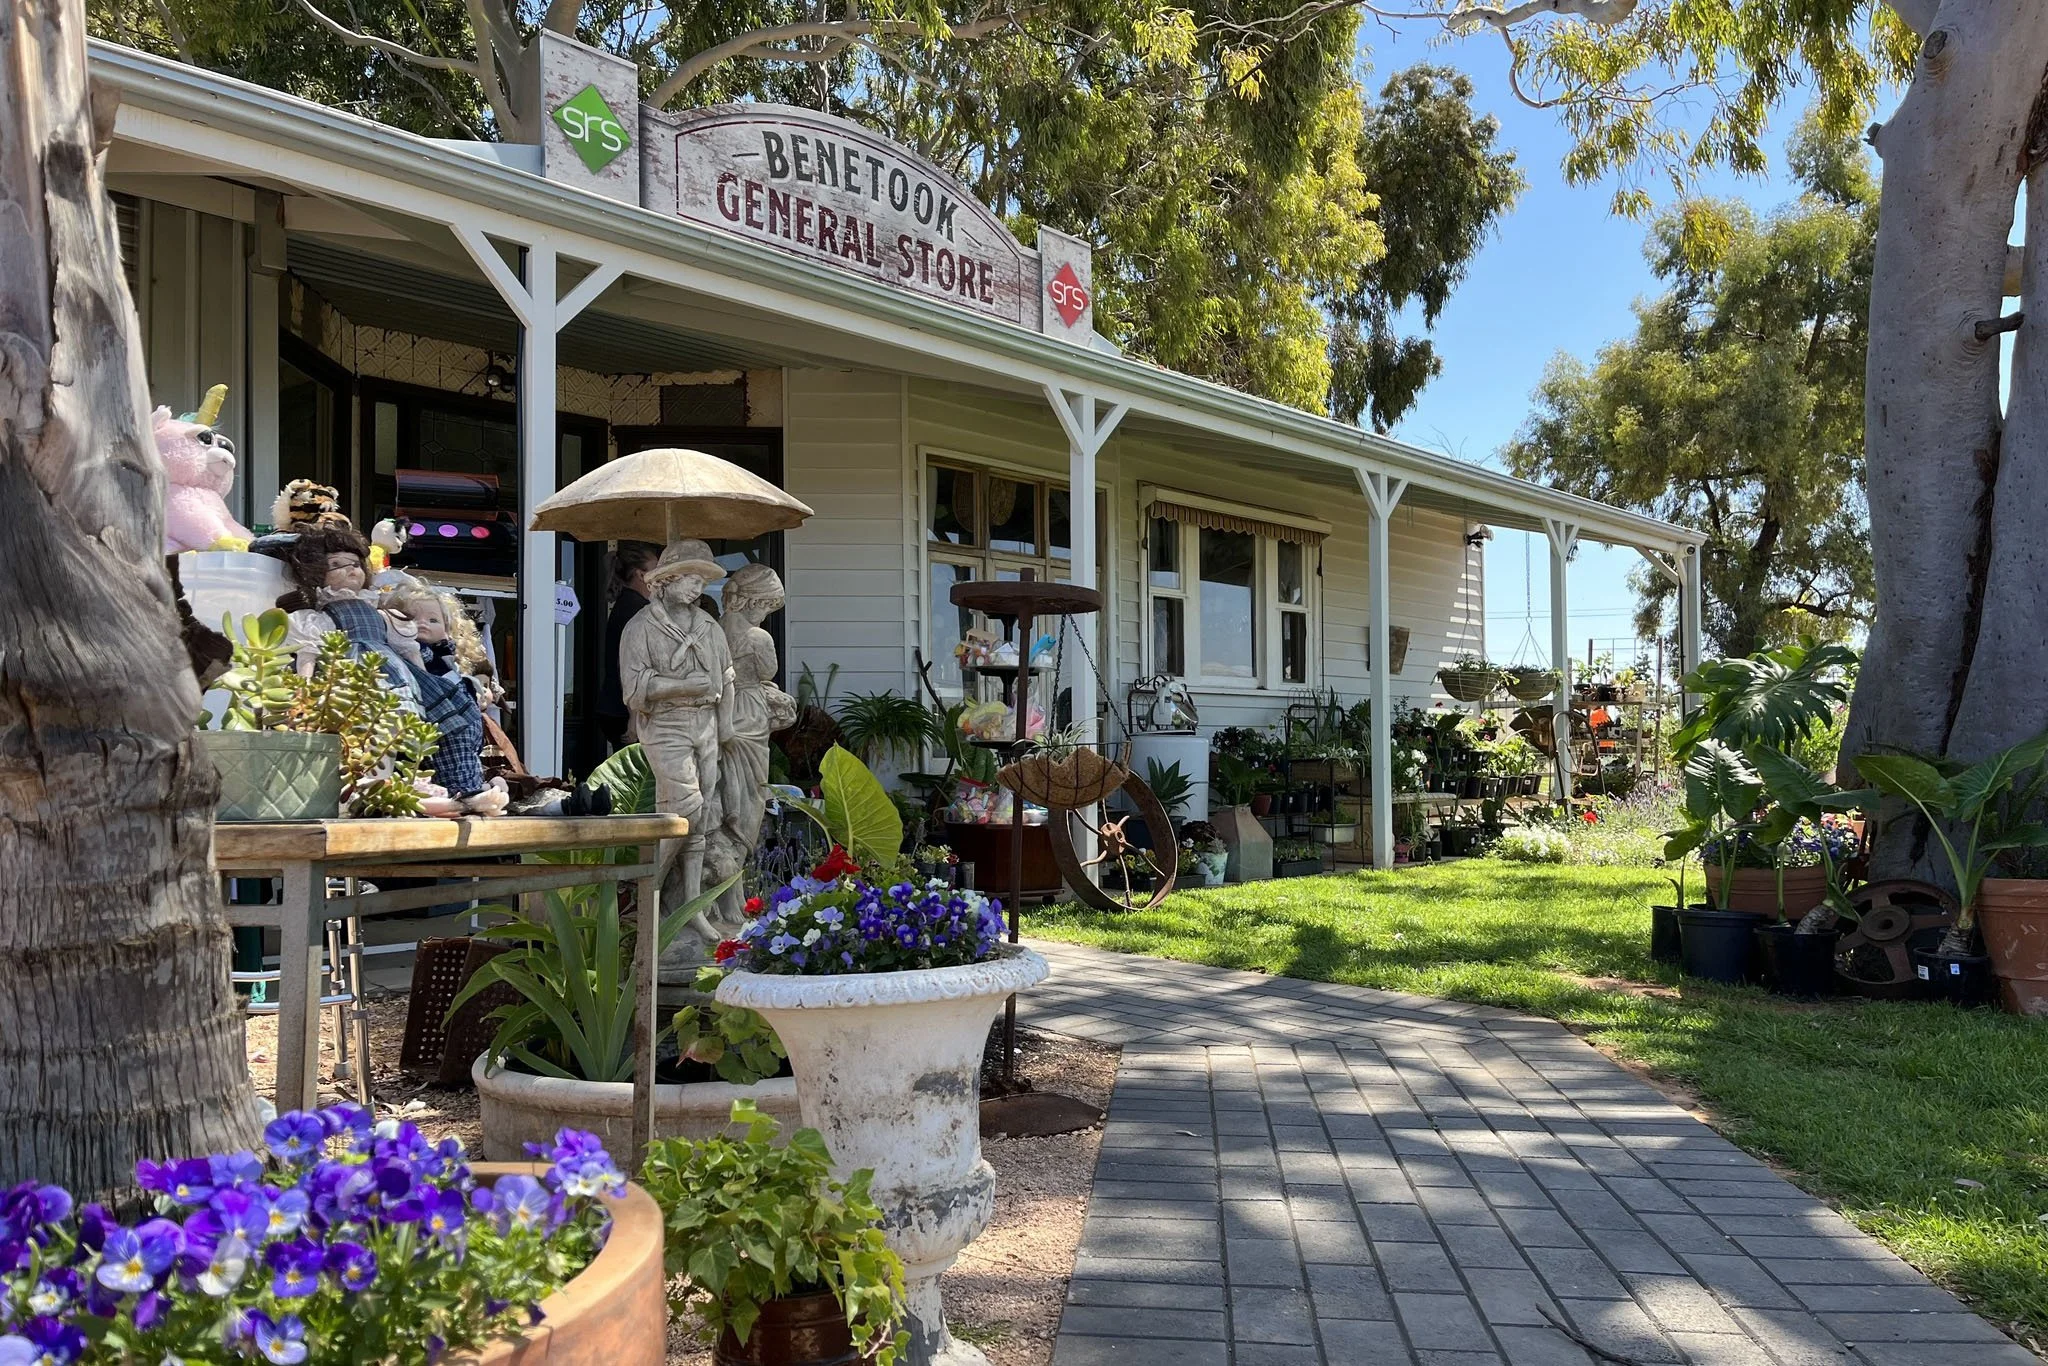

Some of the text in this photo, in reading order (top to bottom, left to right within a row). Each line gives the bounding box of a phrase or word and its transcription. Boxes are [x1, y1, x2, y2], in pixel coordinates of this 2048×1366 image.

[562, 106, 622, 152] srs
[761, 130, 960, 244] BENETOOK
[716, 172, 994, 305] GENERAL STORE
[1051, 280, 1084, 311] srs
